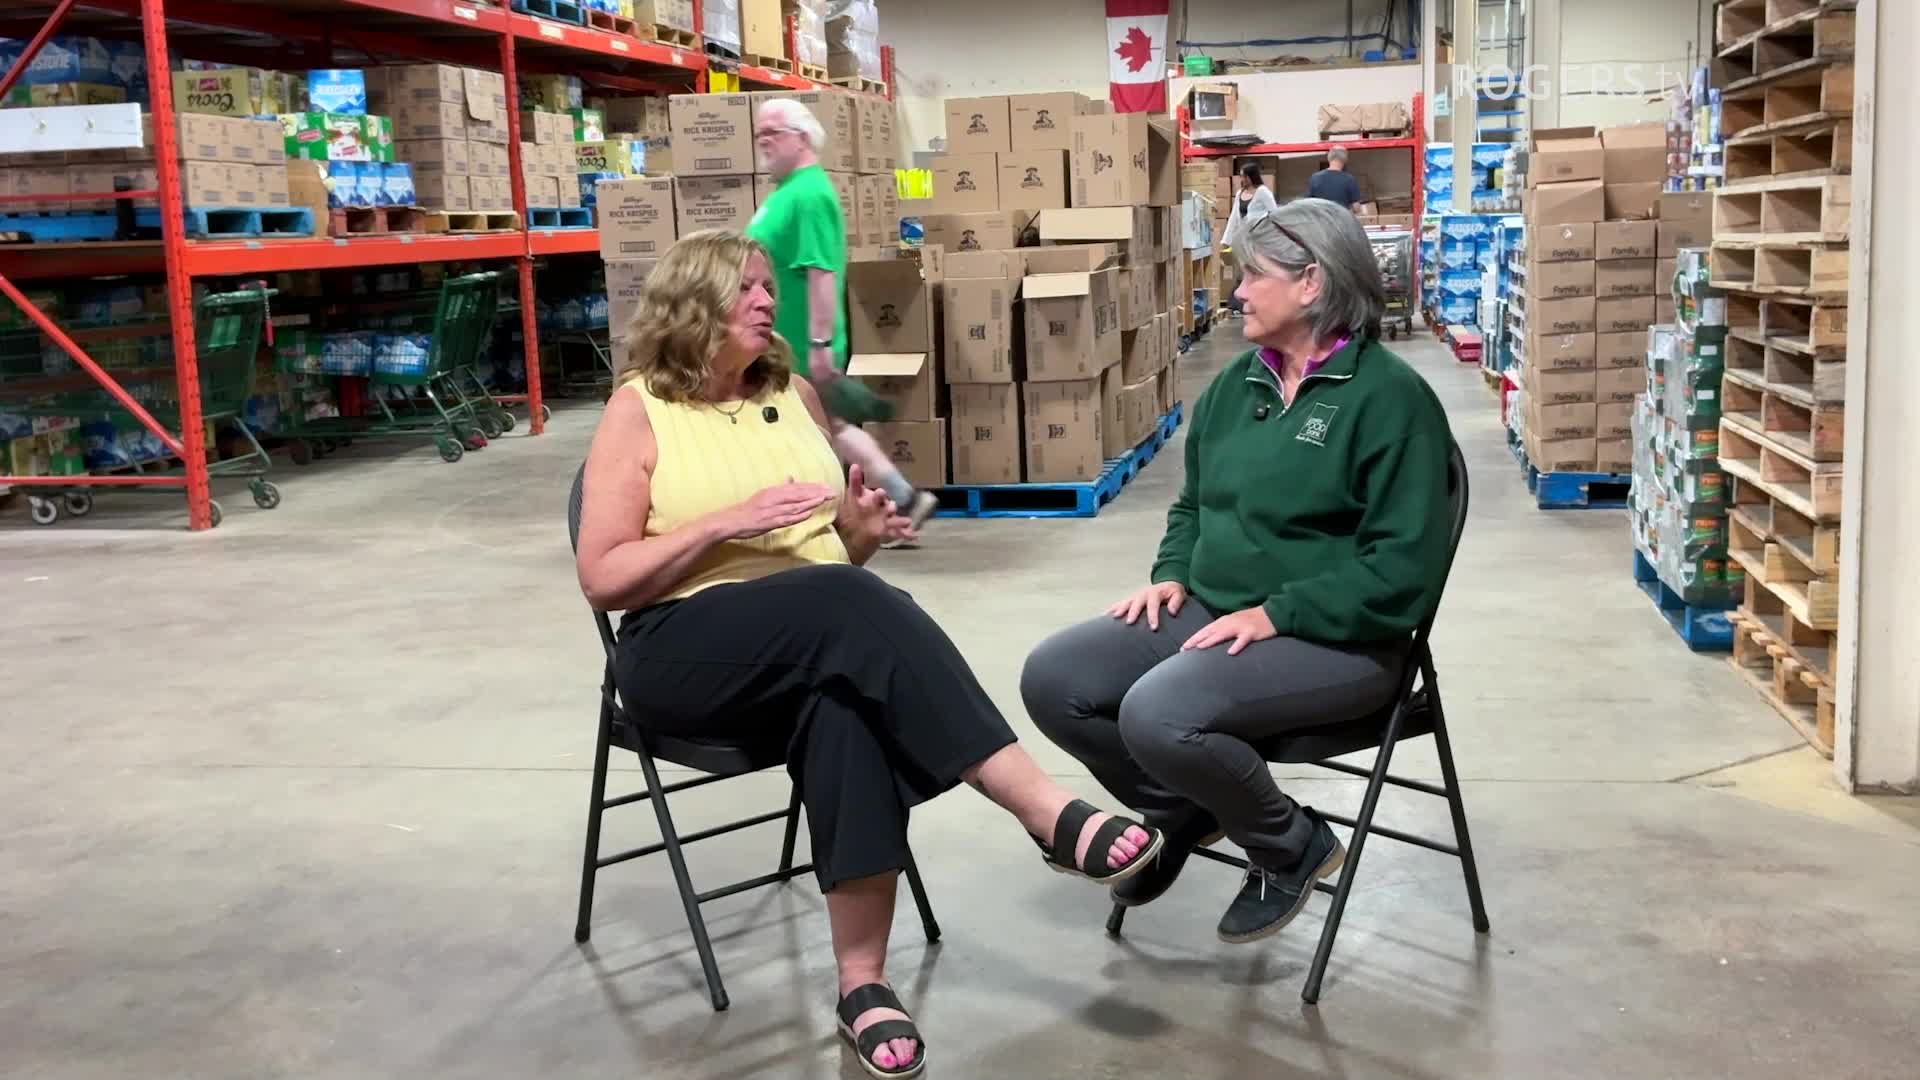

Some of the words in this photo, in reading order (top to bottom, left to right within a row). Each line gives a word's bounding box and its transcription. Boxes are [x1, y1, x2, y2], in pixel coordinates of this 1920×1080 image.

[187, 93, 235, 112] Coors
[702, 125, 735, 133] KRISPIES
[576, 157, 608, 170] Coor
[627, 208, 659, 217] KRISPIES
[704, 207, 736, 215] KRISPIES
[1552, 248, 1579, 258] Family
[1611, 246, 1640, 256] Family
